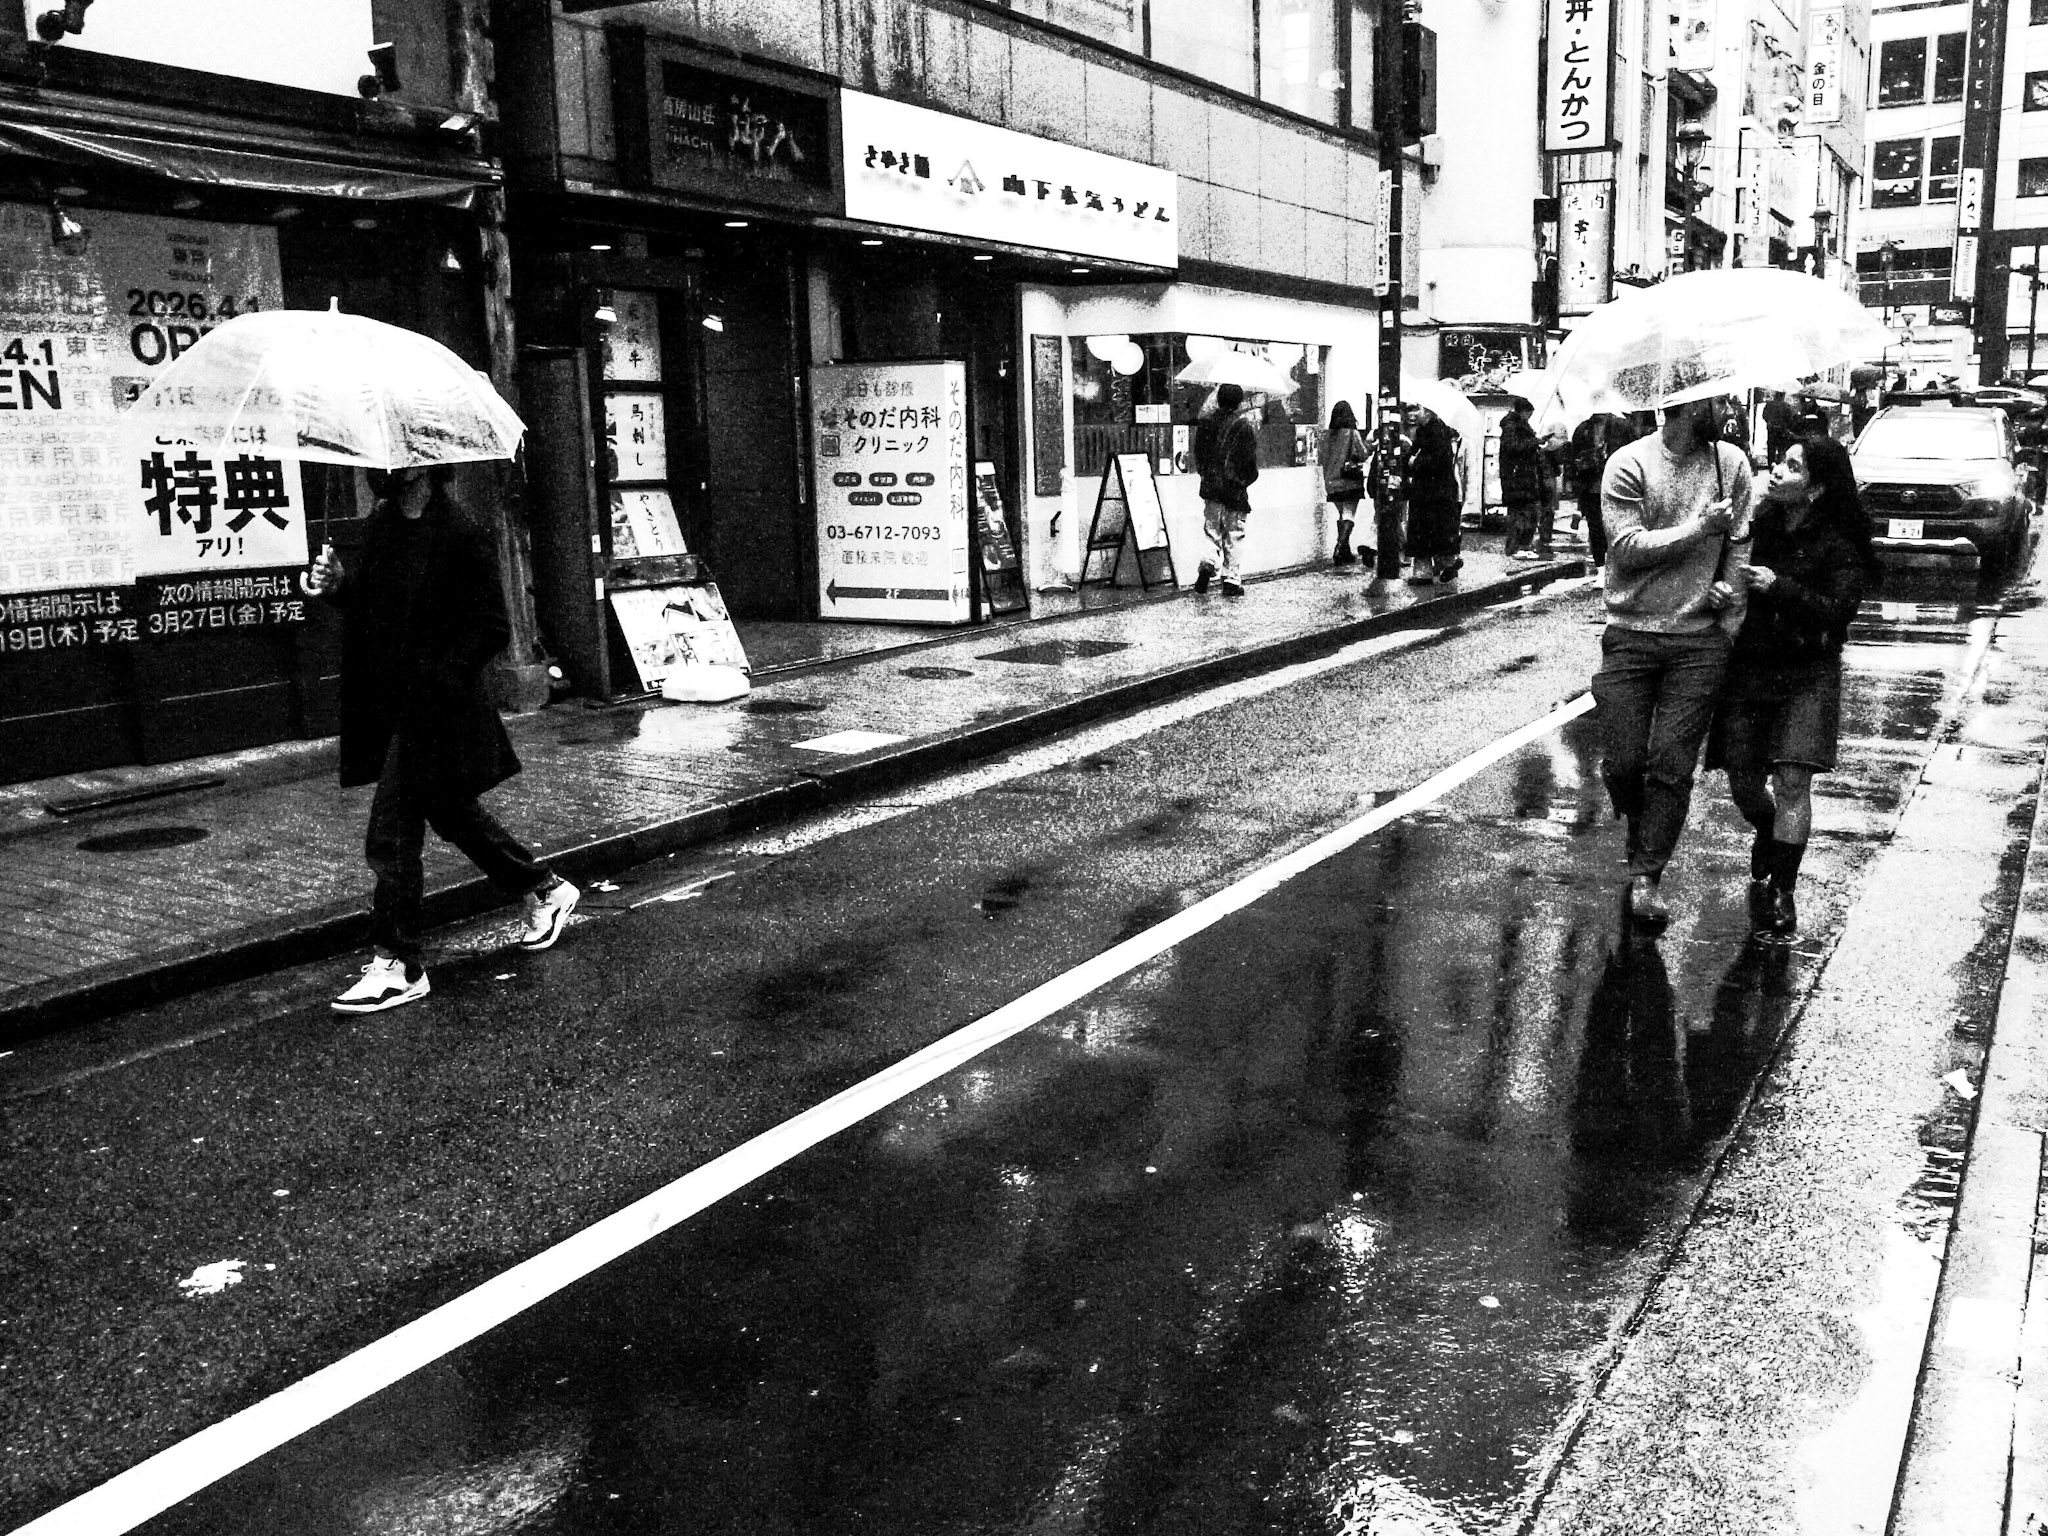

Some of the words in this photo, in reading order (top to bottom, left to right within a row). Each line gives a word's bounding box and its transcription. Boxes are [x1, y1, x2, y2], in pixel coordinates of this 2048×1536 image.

[1560, 0, 1592, 141] 丼・とんかつ
[1812, 62, 1826, 105] 金の目
[127, 288, 260, 321] 2026.41
[0, 338, 54, 366] 4.1
[844, 405, 941, 430] そのだ内科
[855, 435, 929, 454] クリニック
[949, 380, 965, 520] そのだ内科
[140, 450, 290, 535] 特典
[196, 537, 244, 557] アリ!
[827, 525, 941, 540] 03-6712-7093
[159, 575, 292, 606] 次の情報開示は
[886, 588, 900, 600] 2F
[93, 618, 140, 643] 予定
[149, 604, 265, 634] 3月27日(金)
[270, 600, 306, 623] 予定
